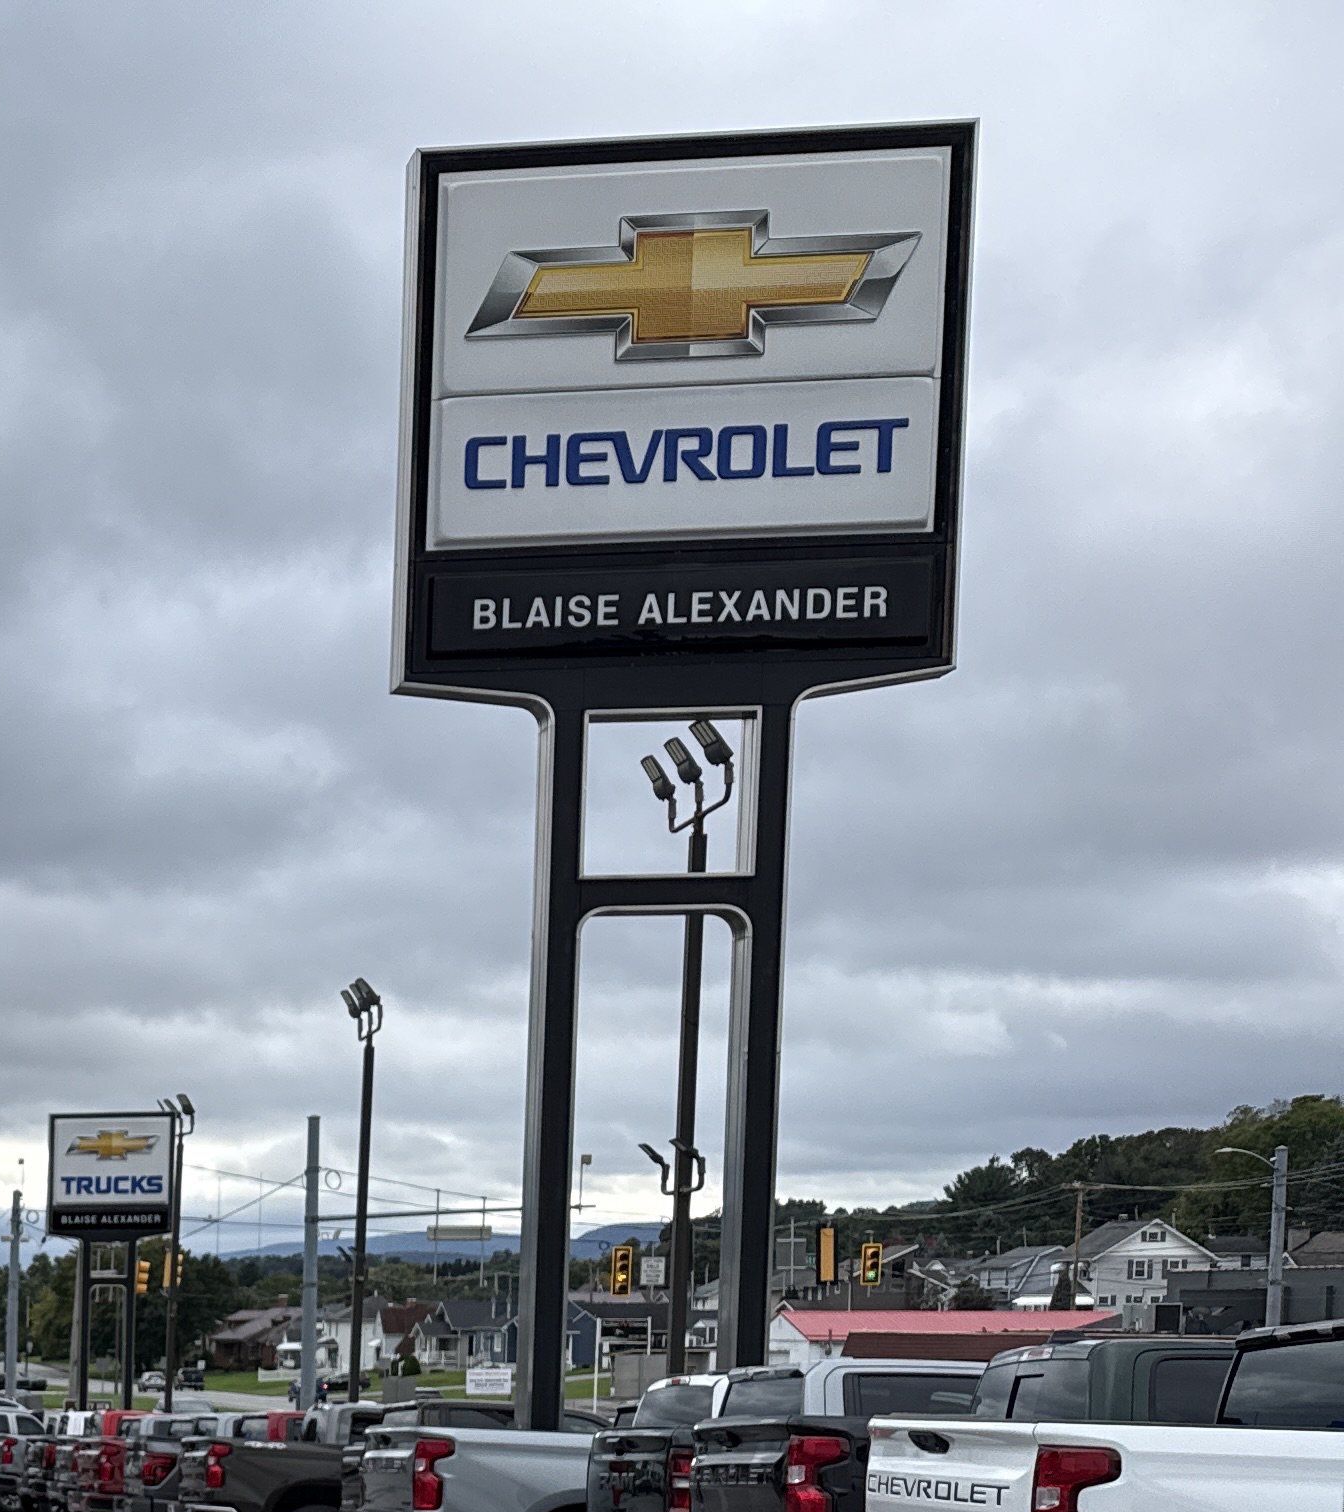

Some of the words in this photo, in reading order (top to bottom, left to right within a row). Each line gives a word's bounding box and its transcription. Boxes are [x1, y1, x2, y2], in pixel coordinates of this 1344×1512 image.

[463, 417, 910, 489] CHEVROLET
[472, 594, 620, 631] BLAISE
[637, 586, 889, 626] ALEXANDER
[60, 1174, 163, 1195] TRUCKS
[60, 1214, 98, 1225] BLAISE
[100, 1213, 162, 1224] ALEXANDER
[867, 1474, 1010, 1506] CHEVROLET
